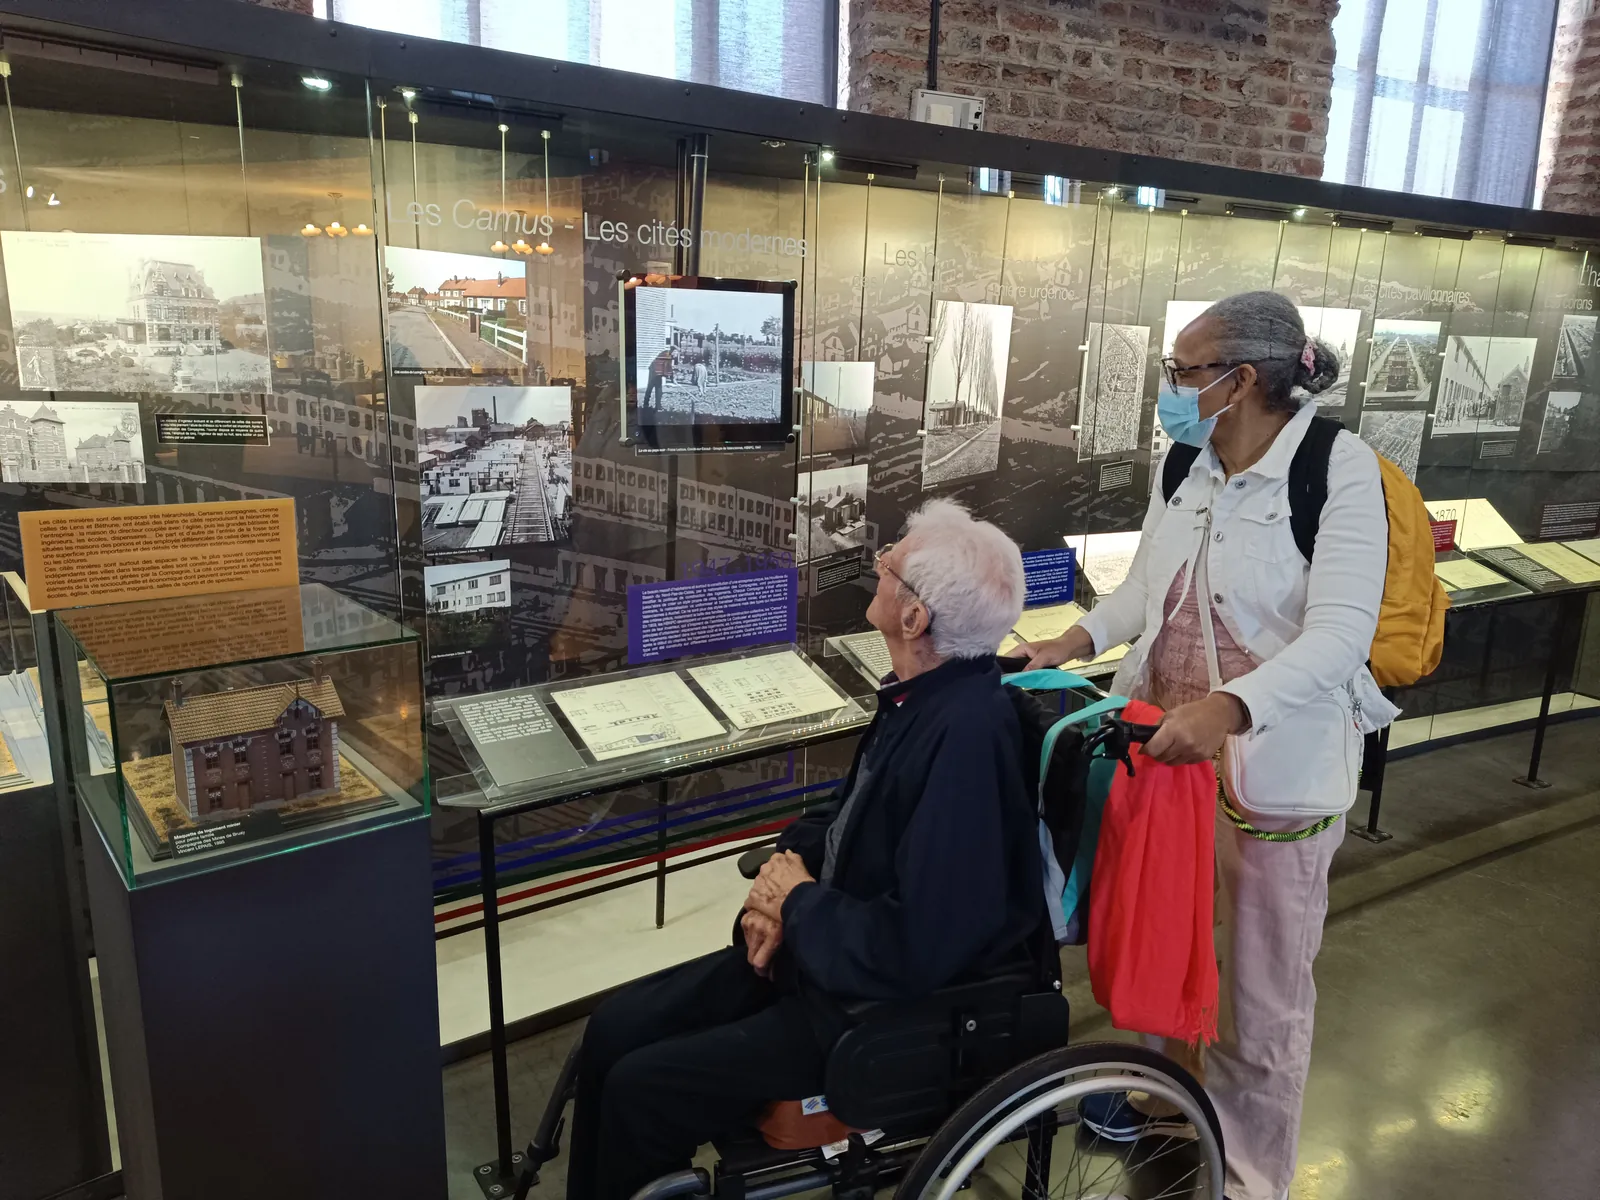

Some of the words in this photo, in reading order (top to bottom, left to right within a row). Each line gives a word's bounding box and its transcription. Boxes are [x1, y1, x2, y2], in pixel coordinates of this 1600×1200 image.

[387, 193, 441, 226] Les
[453, 199, 554, 236] Camus
[584, 212, 628, 243] Les
[637, 219, 692, 248] cités
[700, 227, 808, 258] modernes
[884, 243, 917, 267] Les
[1029, 285, 1075, 301] urgence
[1405, 284, 1471, 304] pavillonnaires
[176, 841, 202, 849] Compagnie
